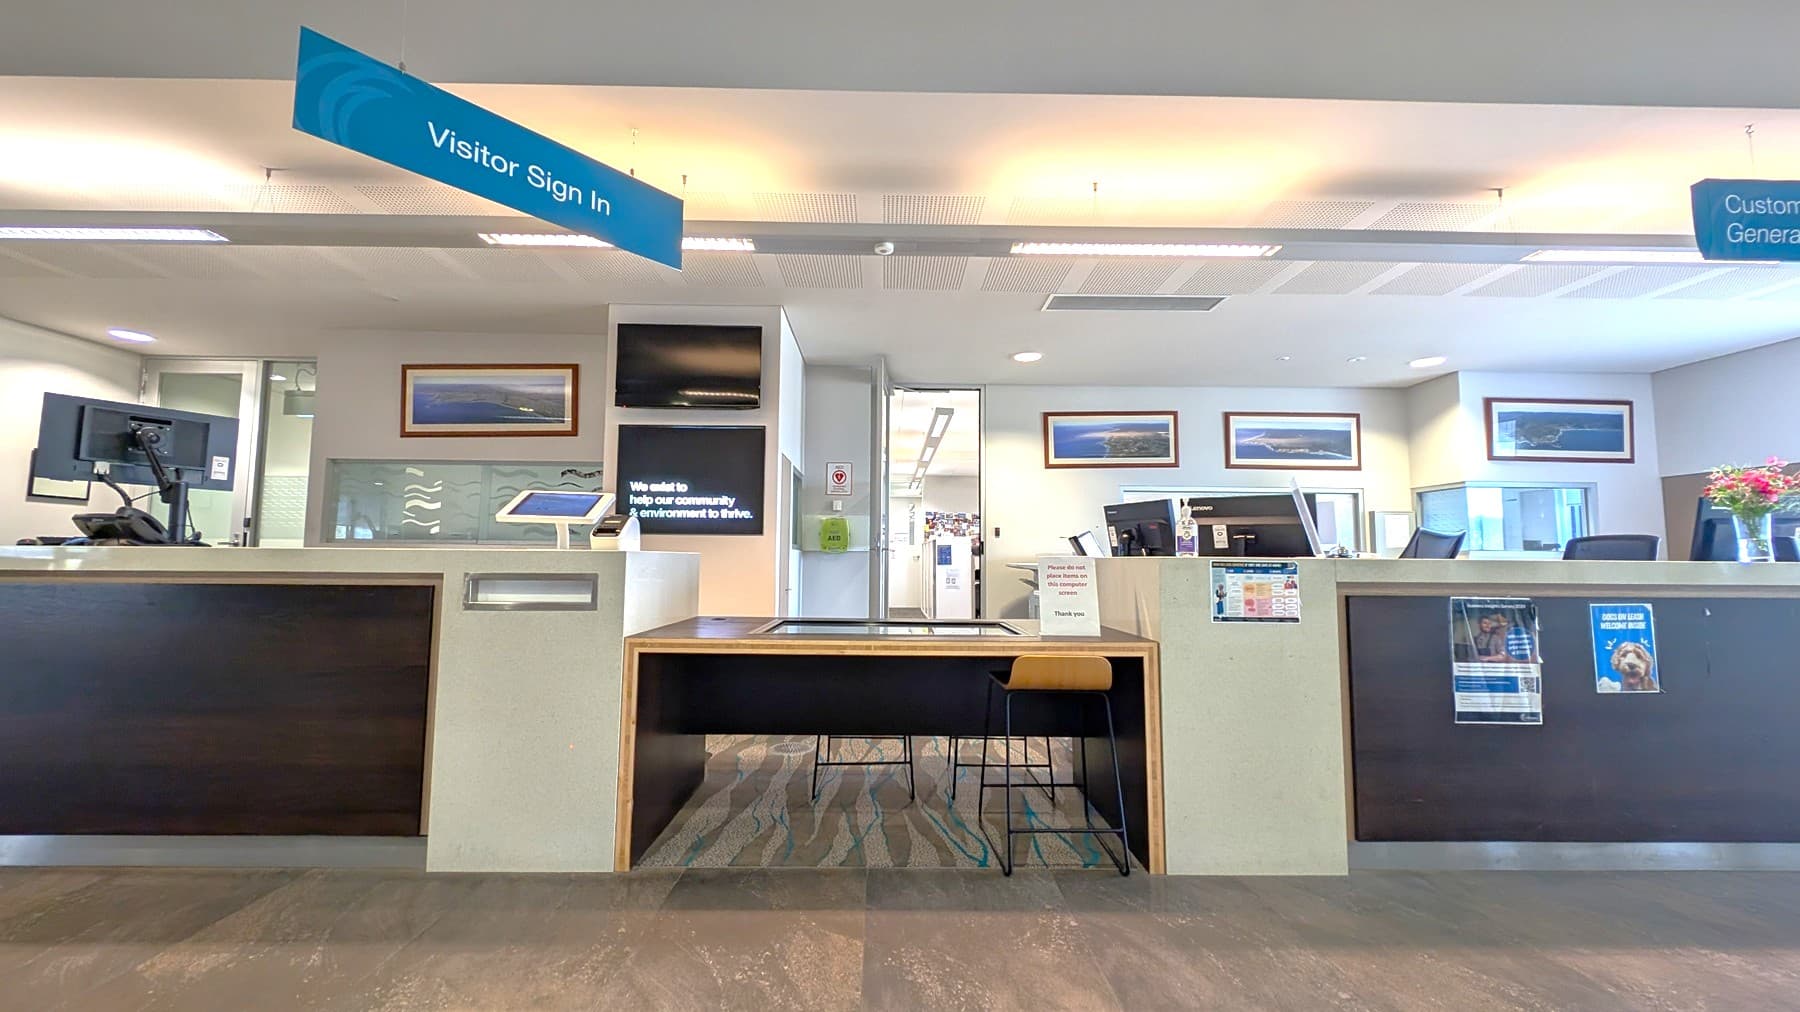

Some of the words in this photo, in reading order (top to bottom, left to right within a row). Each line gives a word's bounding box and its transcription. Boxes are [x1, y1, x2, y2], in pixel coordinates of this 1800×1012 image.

[427, 121, 519, 176] Visitor
[527, 165, 582, 205] Sign
[591, 190, 610, 216] In
[1727, 222, 1800, 244] Genera
[629, 481, 648, 492] We
[649, 482, 675, 492] exist
[676, 482, 688, 492] to
[629, 494, 653, 506] help
[655, 496, 674, 505] our
[674, 495, 736, 508] community
[629, 507, 638, 517] &
[640, 508, 706, 518] environment
[707, 509, 719, 518] to
[720, 509, 753, 519] thrive.
